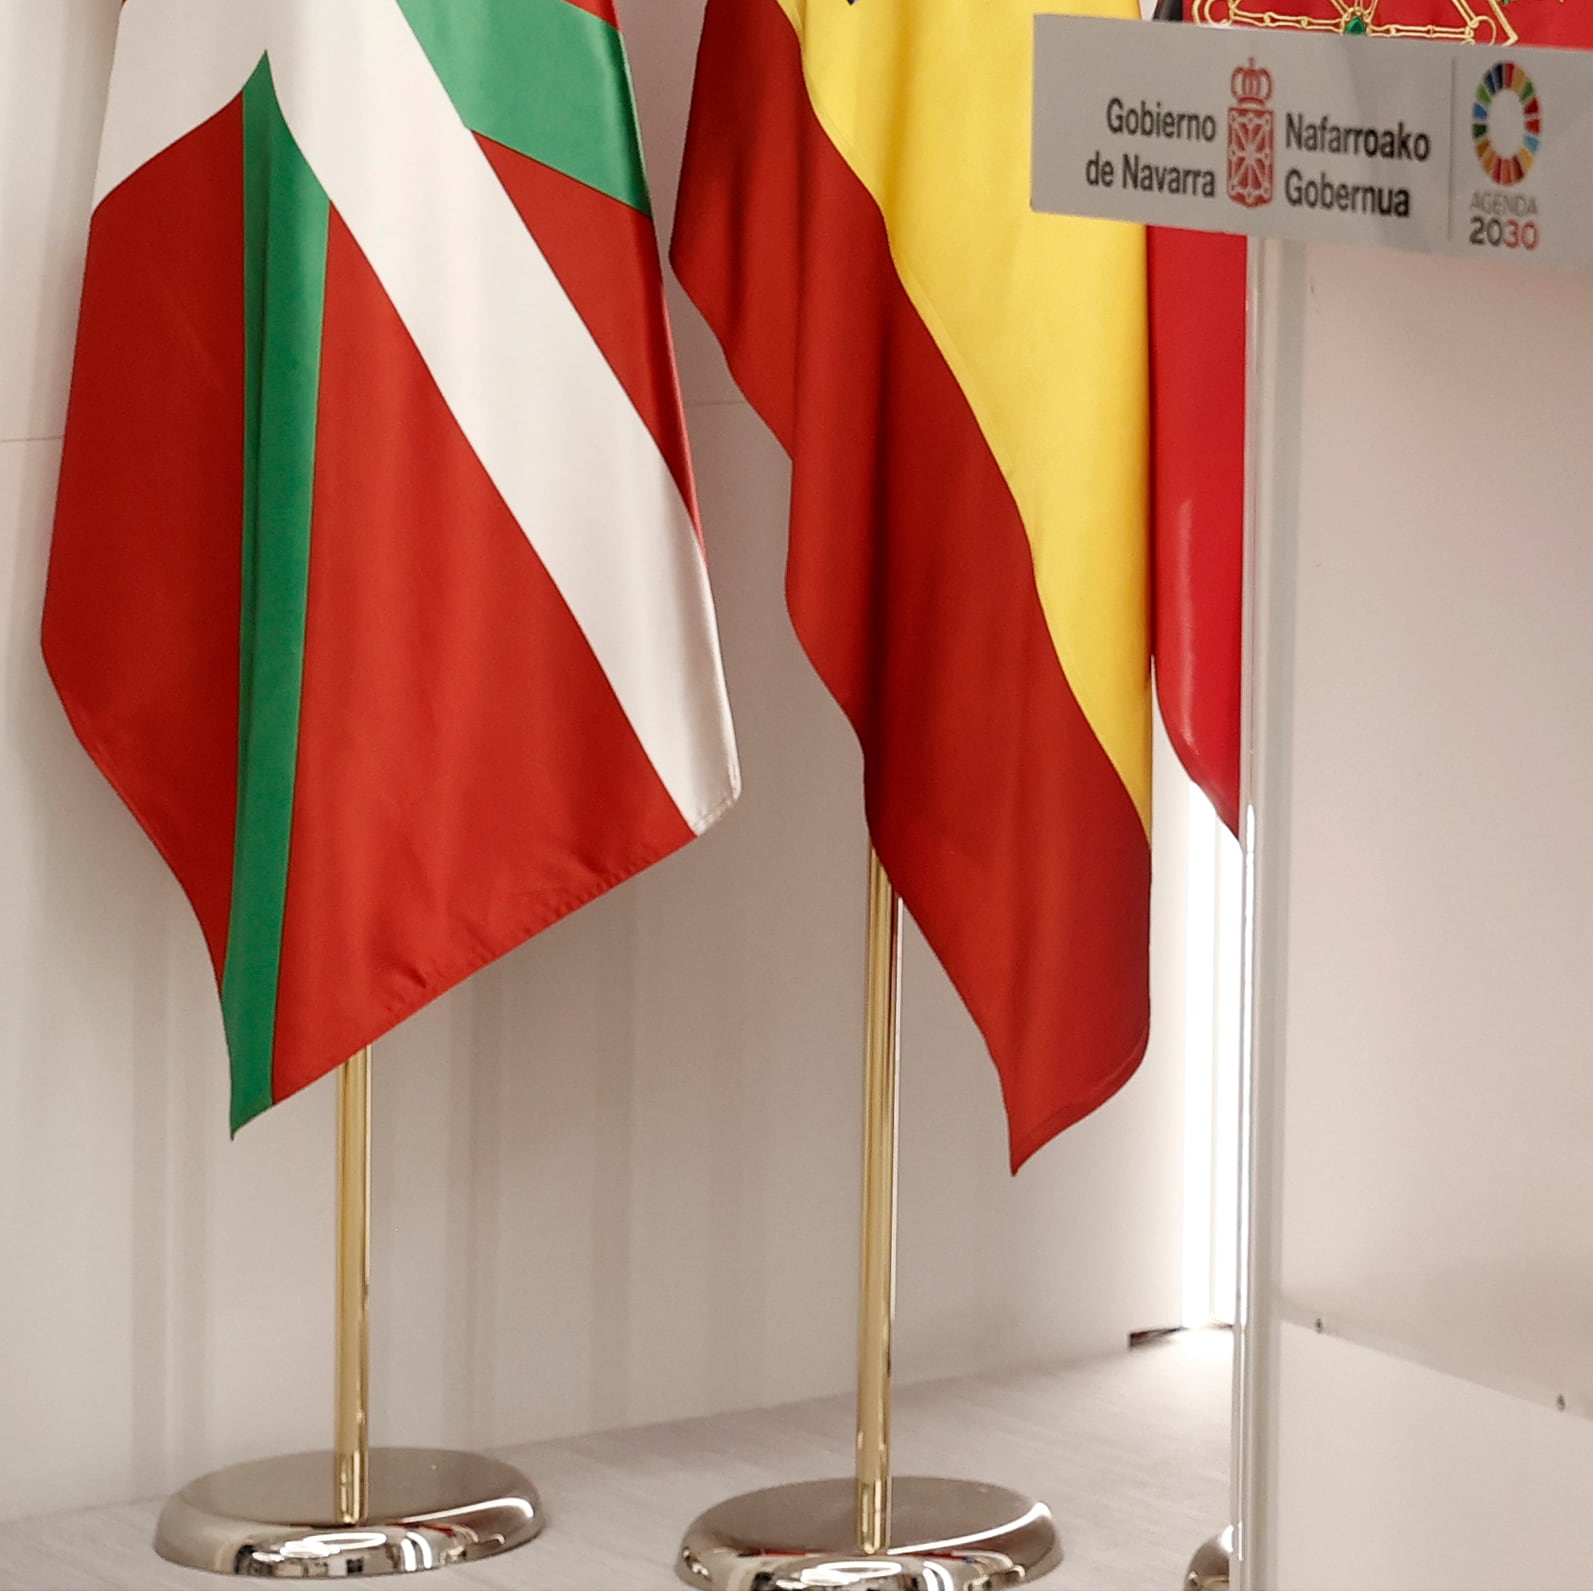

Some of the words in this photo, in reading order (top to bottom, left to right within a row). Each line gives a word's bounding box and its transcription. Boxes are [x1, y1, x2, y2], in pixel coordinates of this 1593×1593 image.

[1106, 97, 1216, 142] Gobierno
[1285, 112, 1430, 162] Nafarroako
[1085, 150, 1115, 188] de
[1122, 153, 1215, 198] Navarra
[1285, 168, 1410, 217] Gobernua
[1470, 191, 1538, 217] AGENDA
[1469, 216, 1538, 251] 2030
